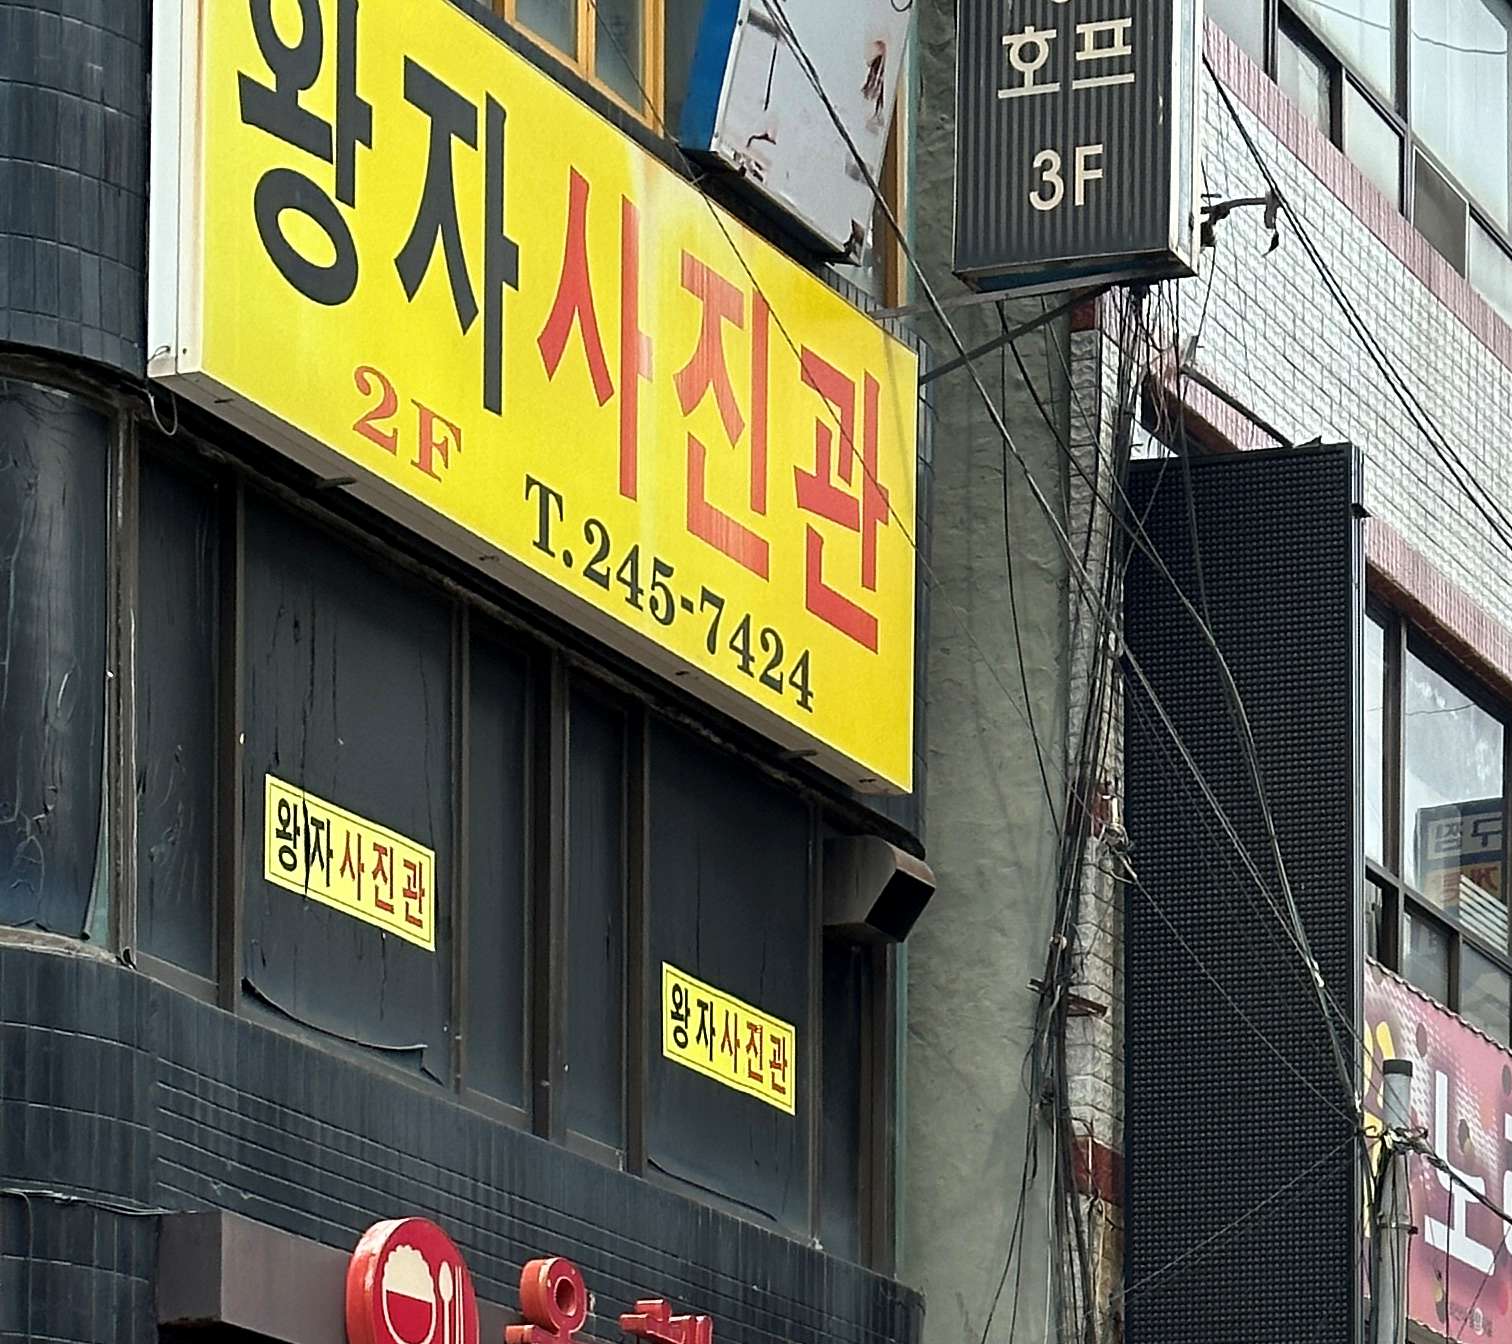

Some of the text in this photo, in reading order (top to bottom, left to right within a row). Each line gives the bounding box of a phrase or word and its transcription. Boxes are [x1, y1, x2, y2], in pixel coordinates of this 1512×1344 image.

[998, 17, 1135, 99] 호프
[1029, 144, 1103, 211] 3F
[238, 0, 890, 654] 왕자사진관
[351, 365, 464, 483] 2F
[525, 473, 816, 714] T.245-7424
[275, 797, 426, 928] 왕자사진관
[670, 982, 789, 1096] 왕자사진관
